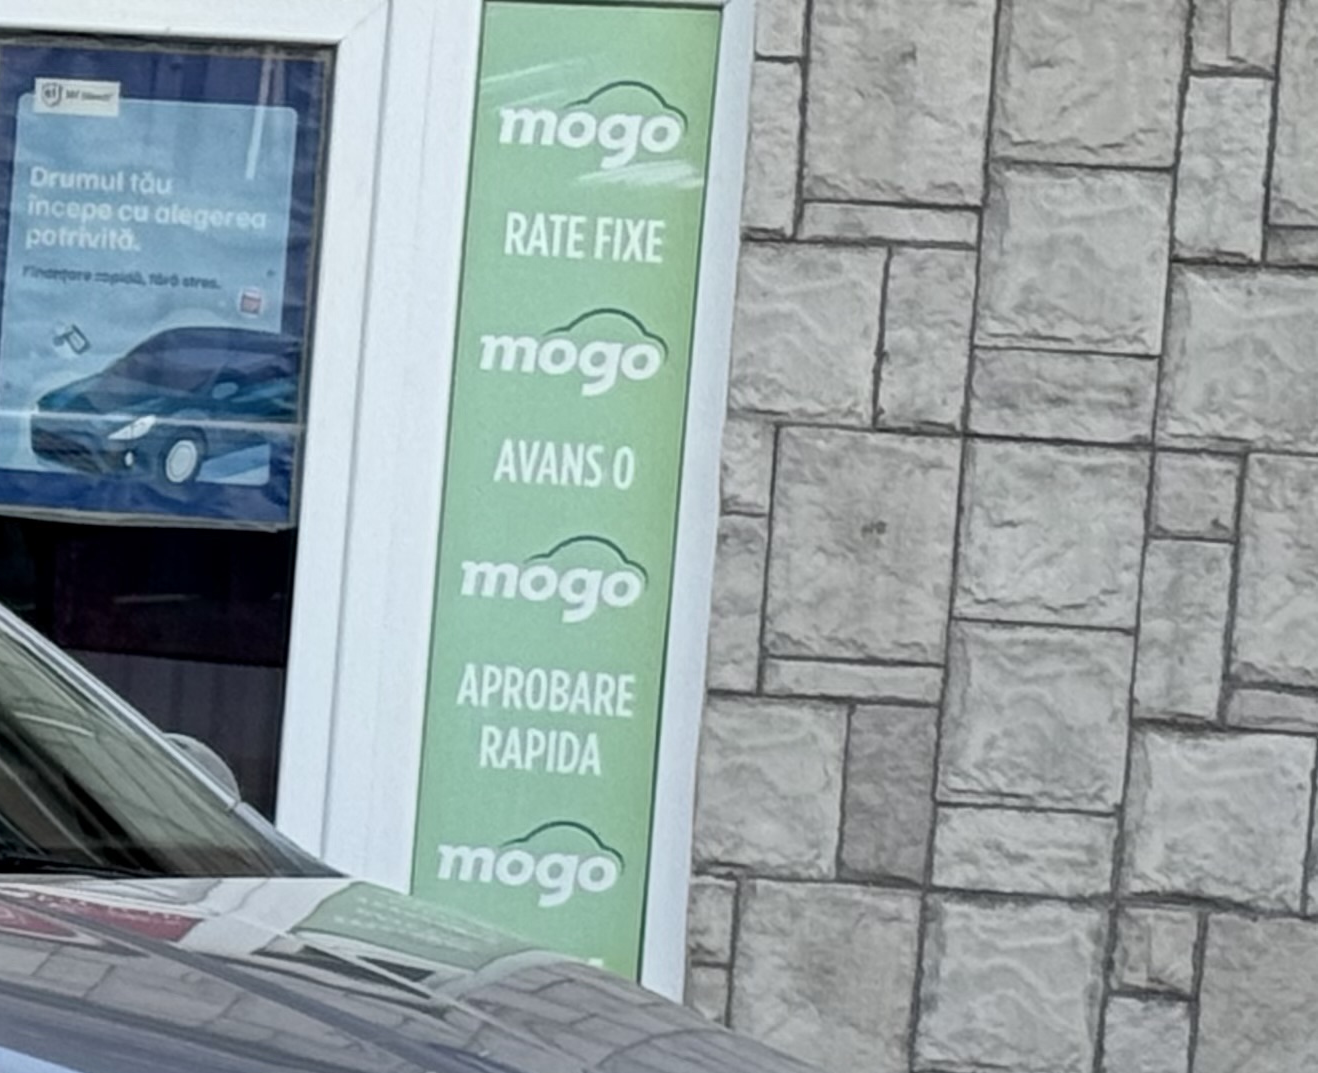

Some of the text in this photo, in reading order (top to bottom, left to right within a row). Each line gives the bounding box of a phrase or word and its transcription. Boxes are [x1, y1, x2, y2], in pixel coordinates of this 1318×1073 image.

[499, 106, 681, 170] mogo
[29, 165, 173, 195] Drumul tău
[25, 226, 141, 251] potrivită.
[27, 195, 267, 232] începe cu alegerea
[504, 211, 666, 263] RATE FIXE
[480, 332, 662, 397] mogo
[494, 438, 604, 489] AVANS
[461, 559, 643, 623] mogo
[456, 662, 635, 718] APROBARE
[480, 725, 602, 777] RAPIDA
[437, 842, 618, 907] mogo
